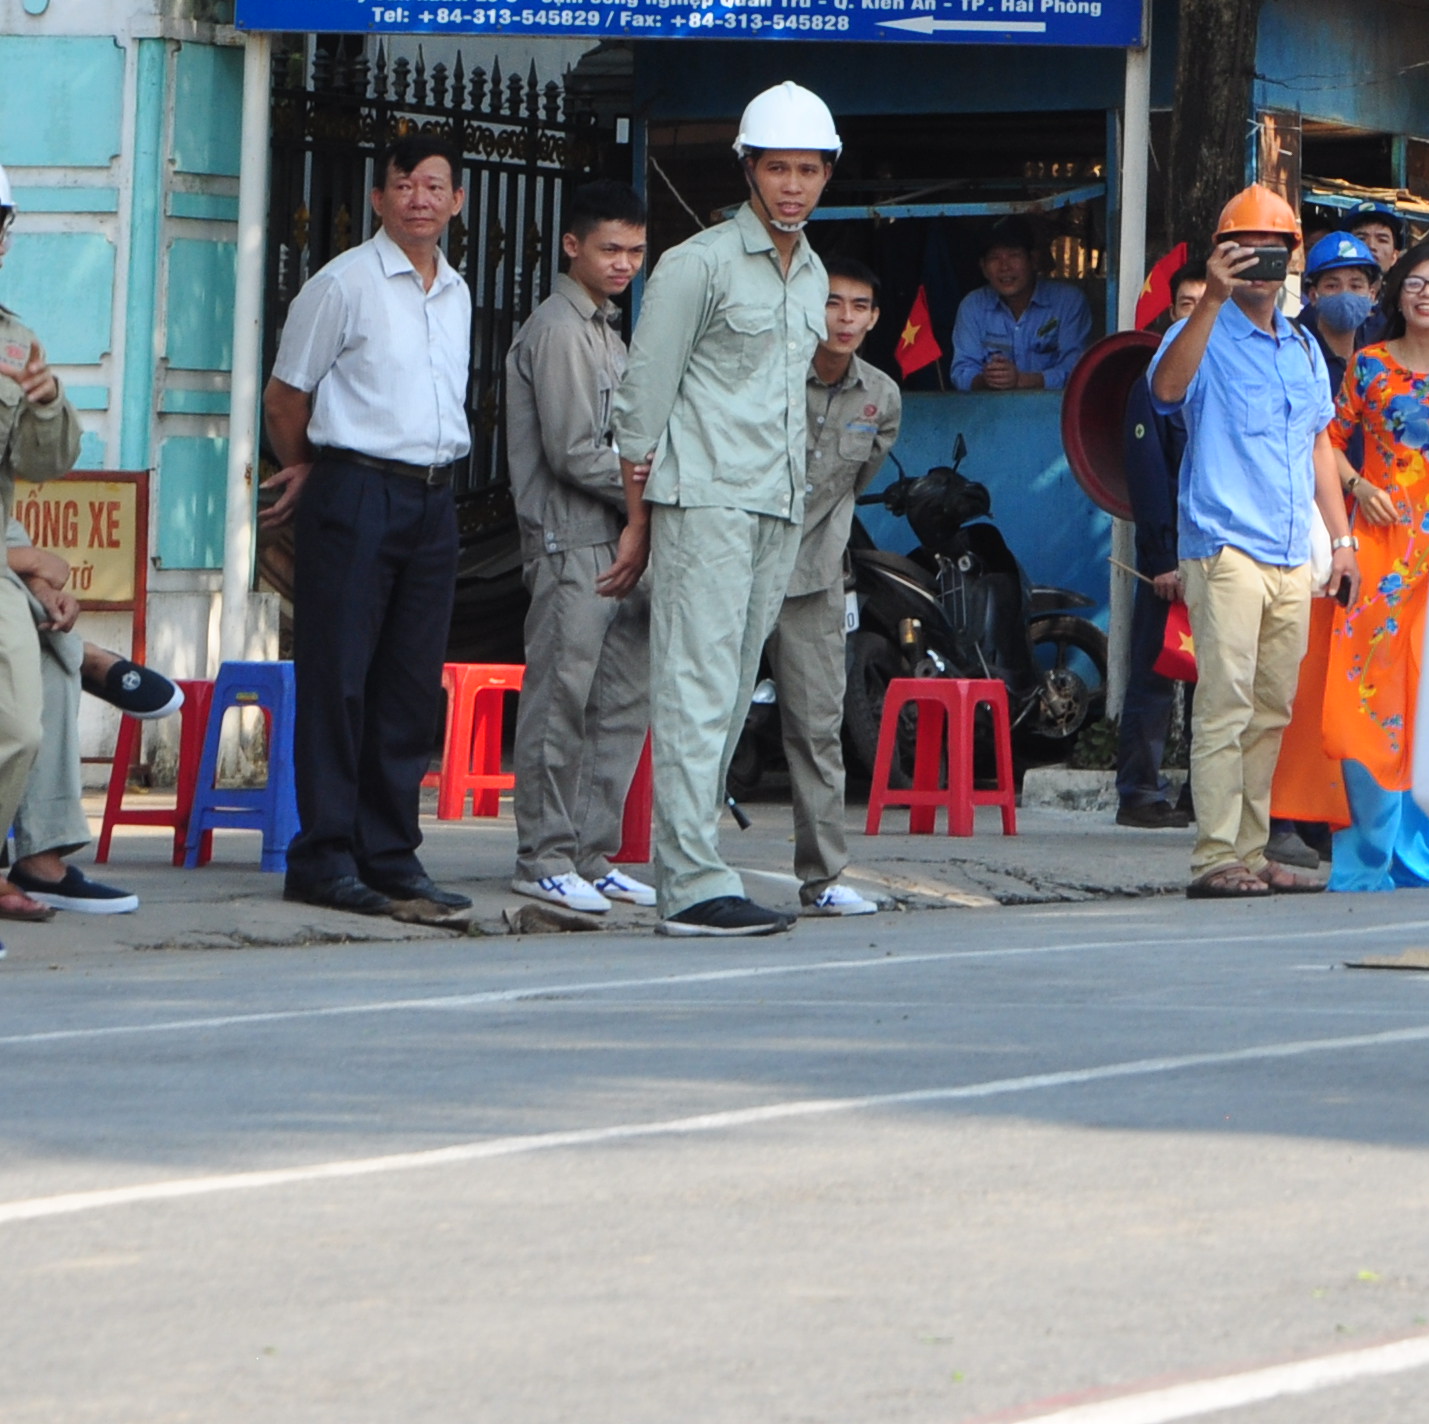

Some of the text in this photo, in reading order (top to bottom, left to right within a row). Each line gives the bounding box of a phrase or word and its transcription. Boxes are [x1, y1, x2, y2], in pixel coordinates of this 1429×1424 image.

[372, 6, 410, 23] Tel:
[419, 8, 600, 25] +84-313-545829
[620, 11, 661, 27] Fax:
[671, 12, 849, 30] +84-313-545828
[87, 500, 121, 549] XE
[70, 559, 94, 590] TỜ
